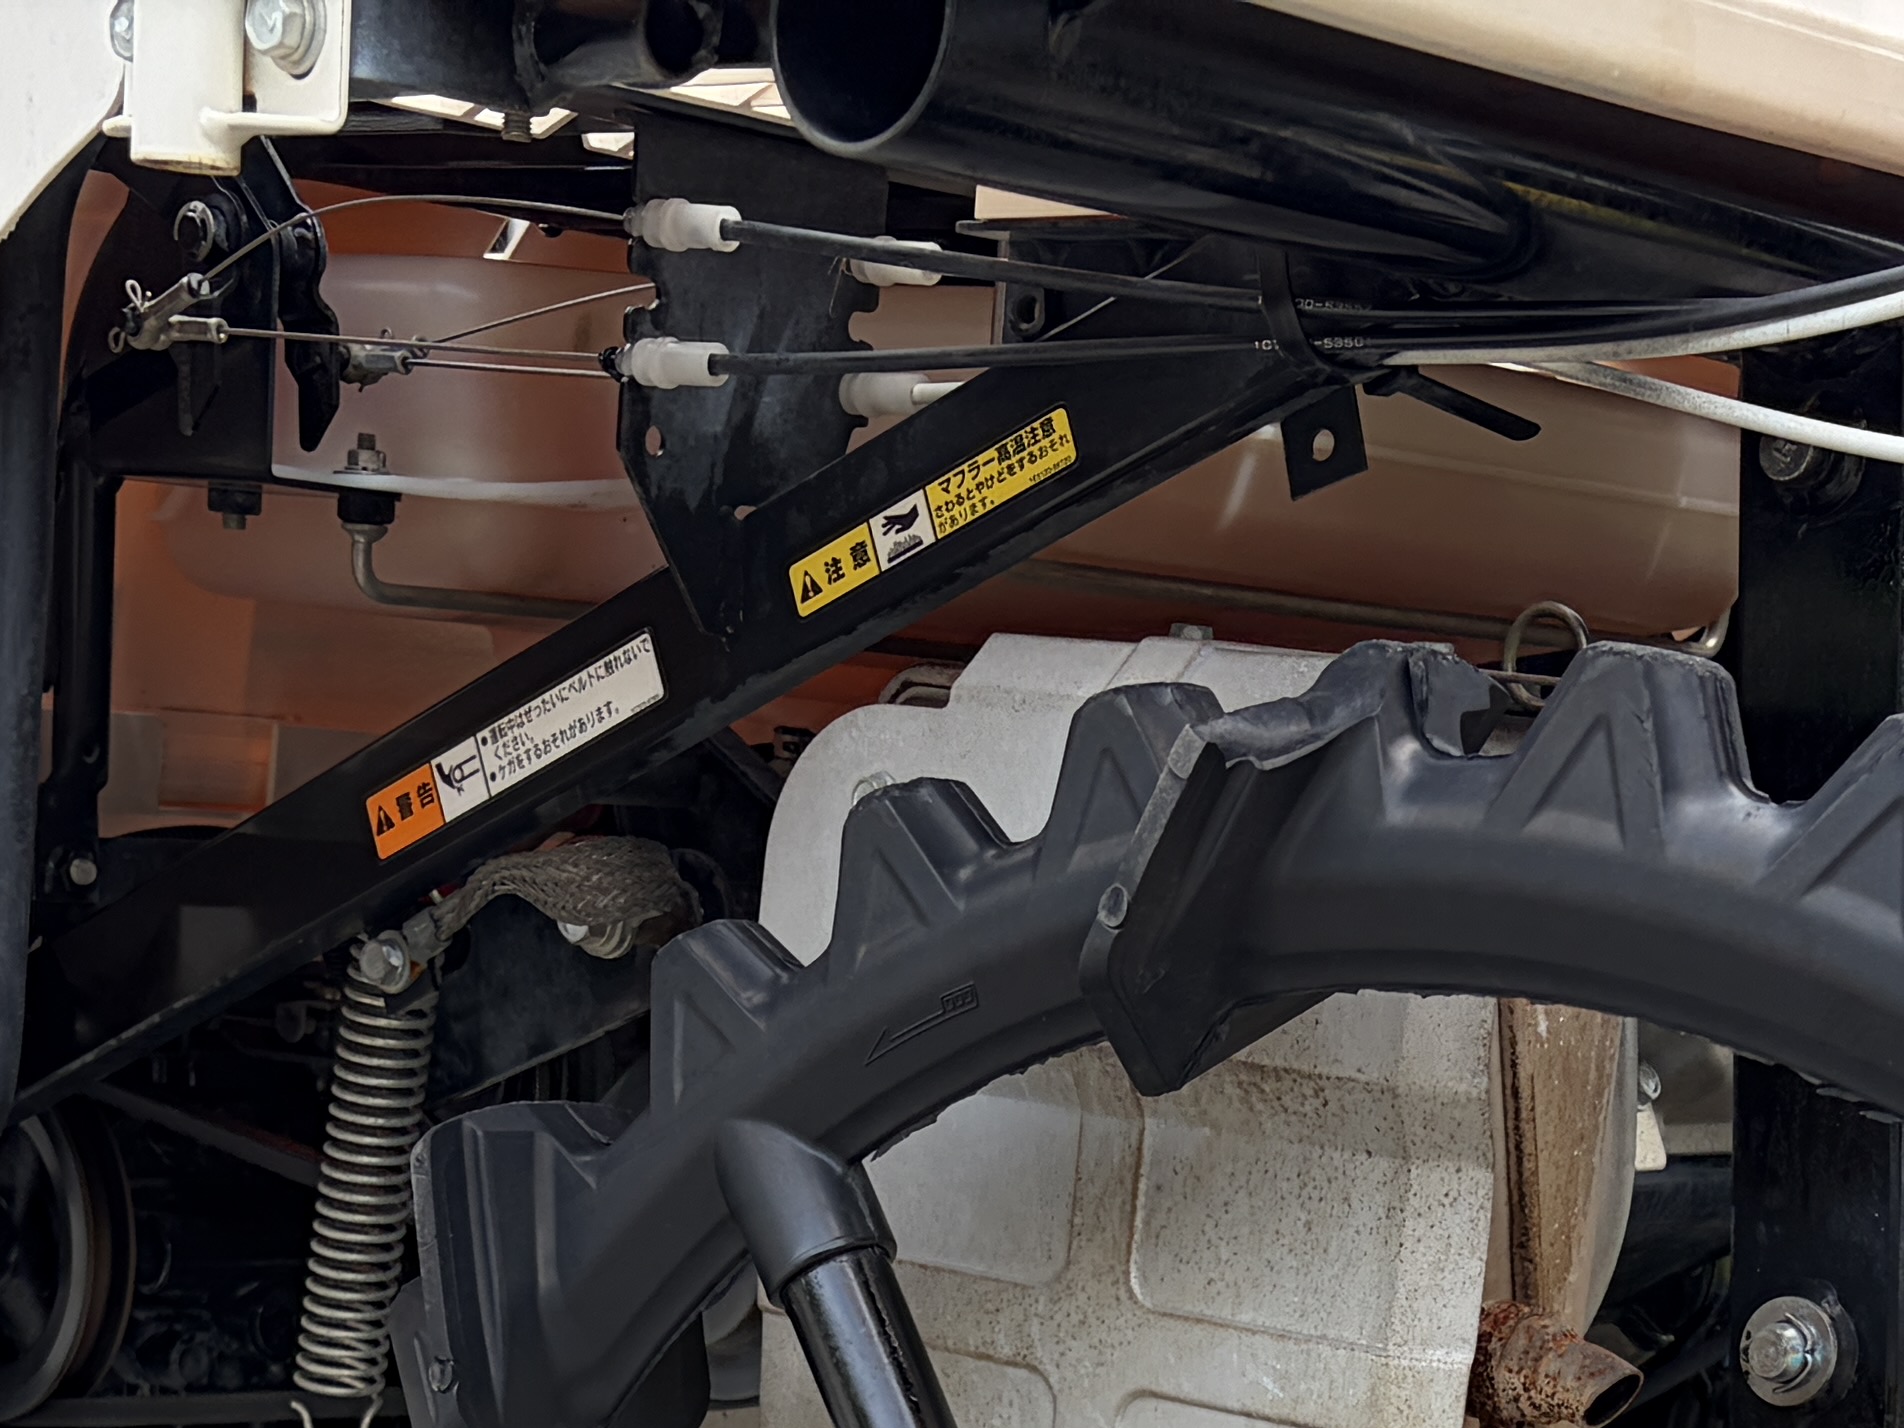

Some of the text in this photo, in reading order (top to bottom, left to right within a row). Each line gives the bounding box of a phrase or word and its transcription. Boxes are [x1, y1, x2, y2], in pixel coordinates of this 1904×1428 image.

[932, 433, 1071, 519] さわるとやけどをするおそれ
[937, 416, 1057, 495] マフラー高温注意
[937, 496, 996, 534] があります。
[823, 541, 871, 585] 注意
[394, 780, 436, 821] 警告
